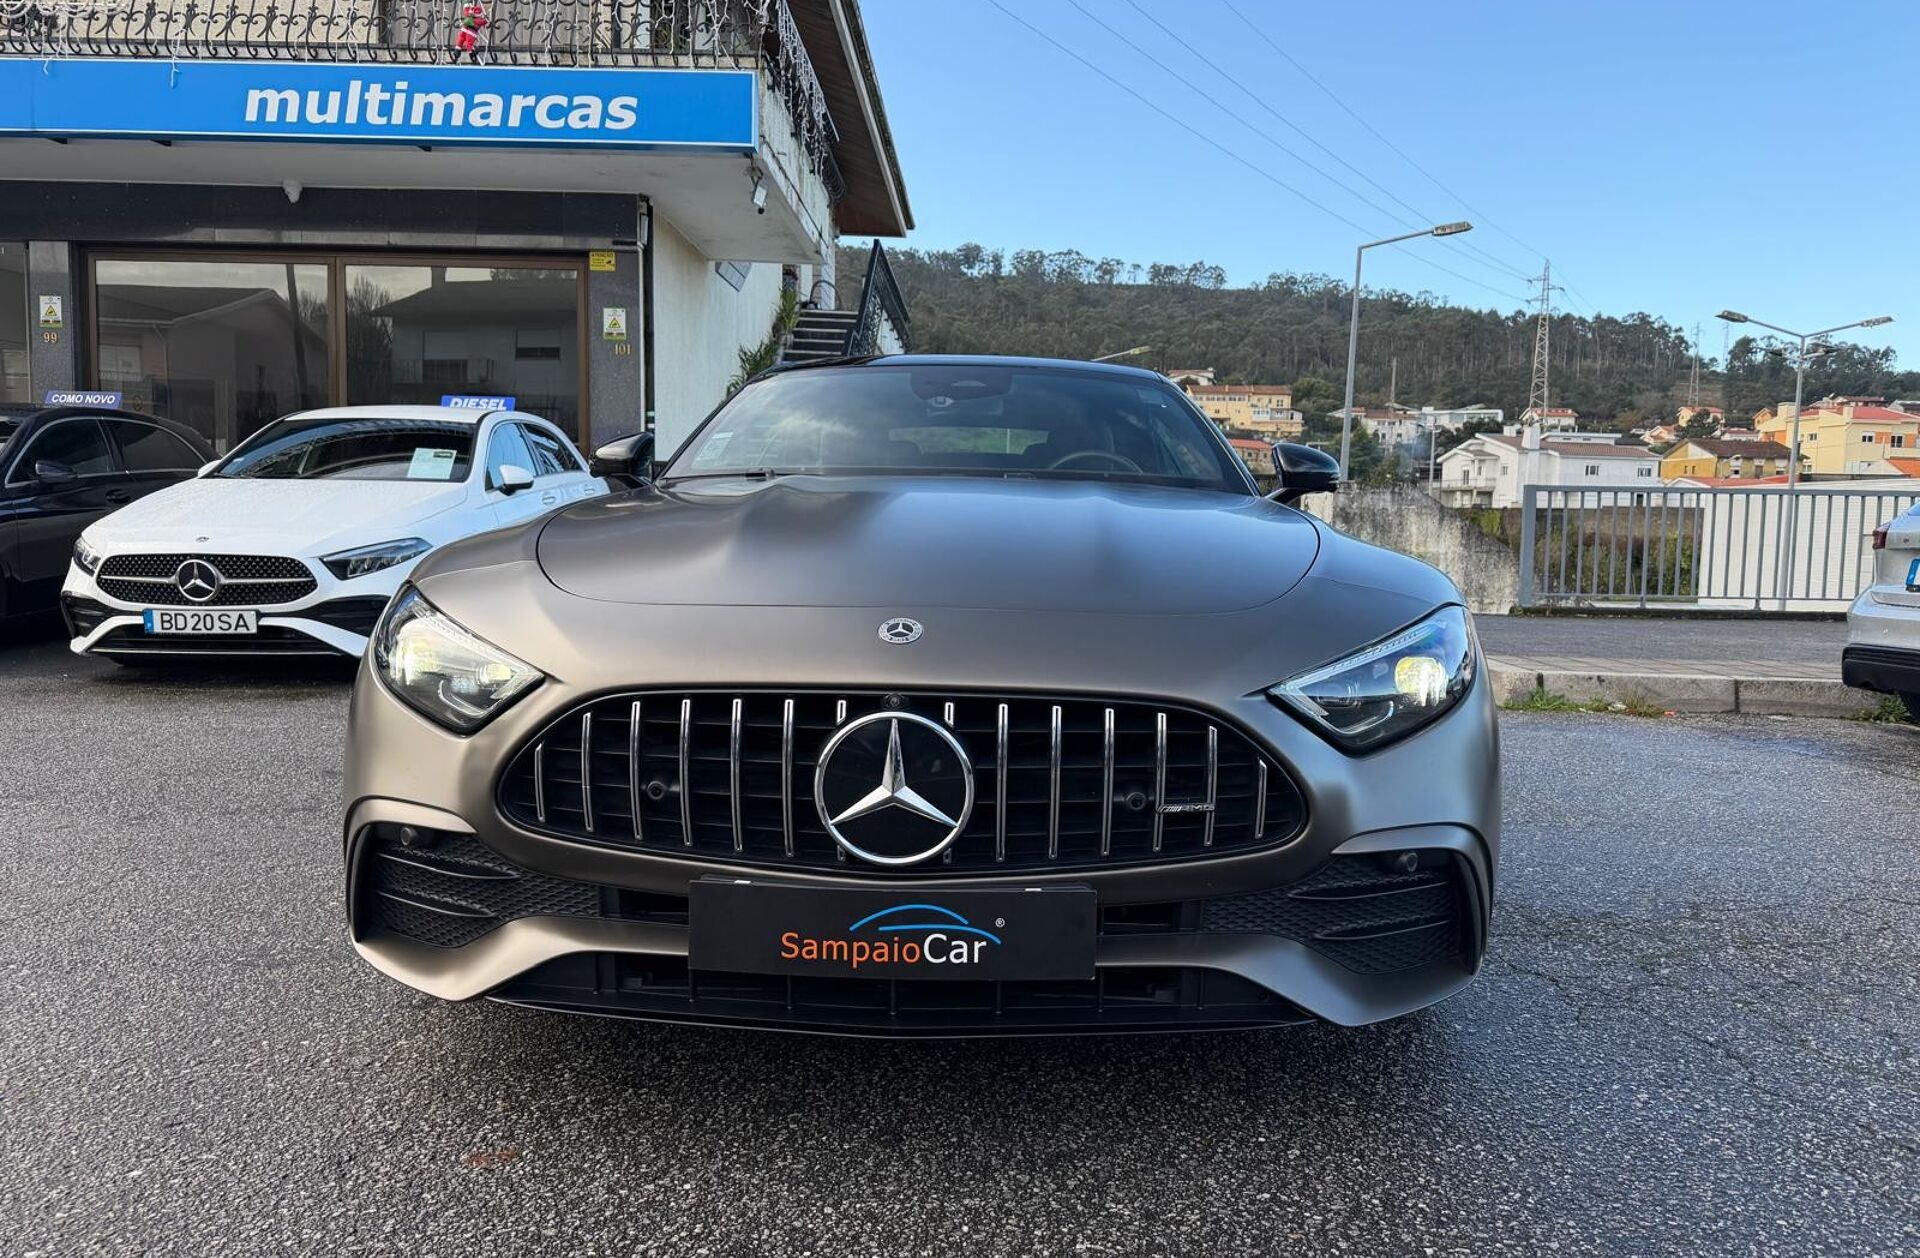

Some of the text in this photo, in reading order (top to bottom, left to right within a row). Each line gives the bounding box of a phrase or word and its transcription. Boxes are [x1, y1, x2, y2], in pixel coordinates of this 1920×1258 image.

[244, 79, 639, 130] multimarcas
[43, 332, 58, 343] 99
[615, 343, 631, 355] 101
[51, 394, 116, 405] COMO NOVO
[449, 397, 508, 411] DIESEL
